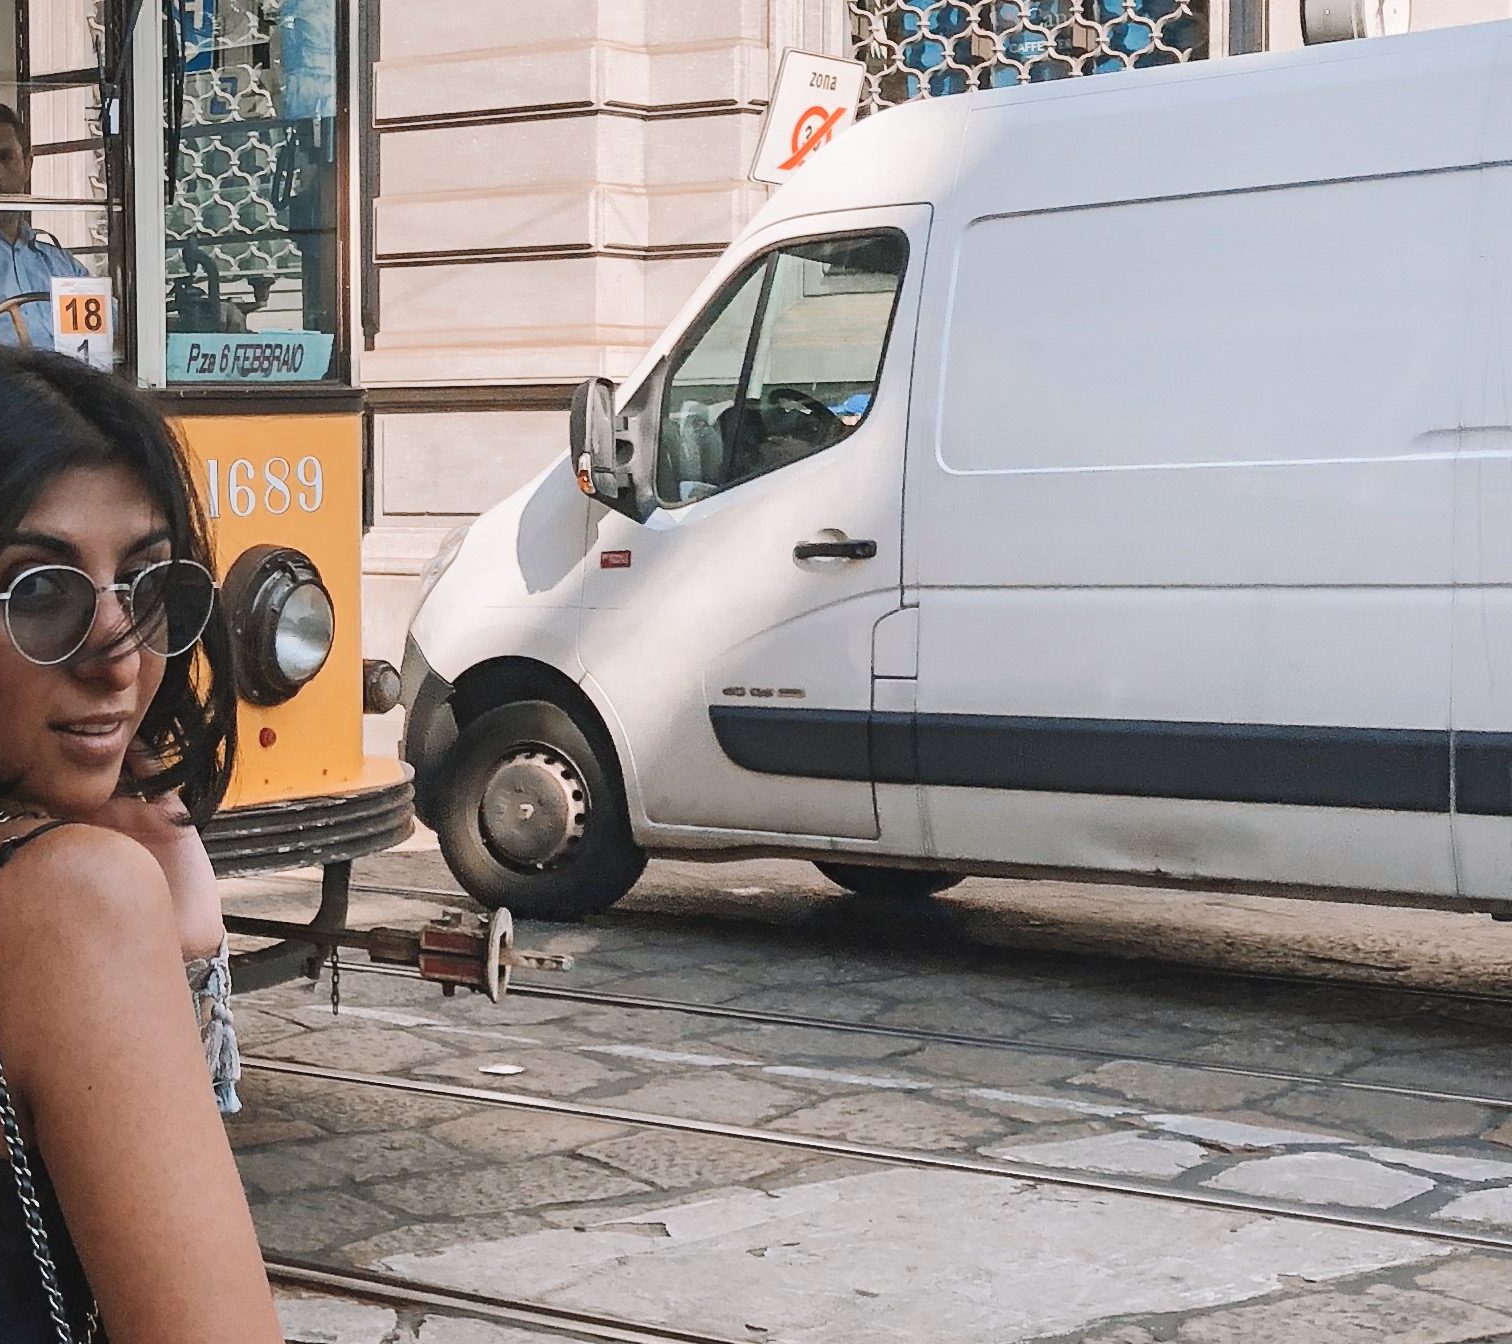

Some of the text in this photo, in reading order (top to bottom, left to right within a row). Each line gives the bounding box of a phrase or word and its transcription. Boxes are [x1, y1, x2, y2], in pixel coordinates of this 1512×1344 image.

[809, 71, 838, 91] zona
[65, 298, 102, 331] 18
[187, 343, 305, 377] P.za 6 FEBBRAIO
[207, 455, 323, 519] 1689
